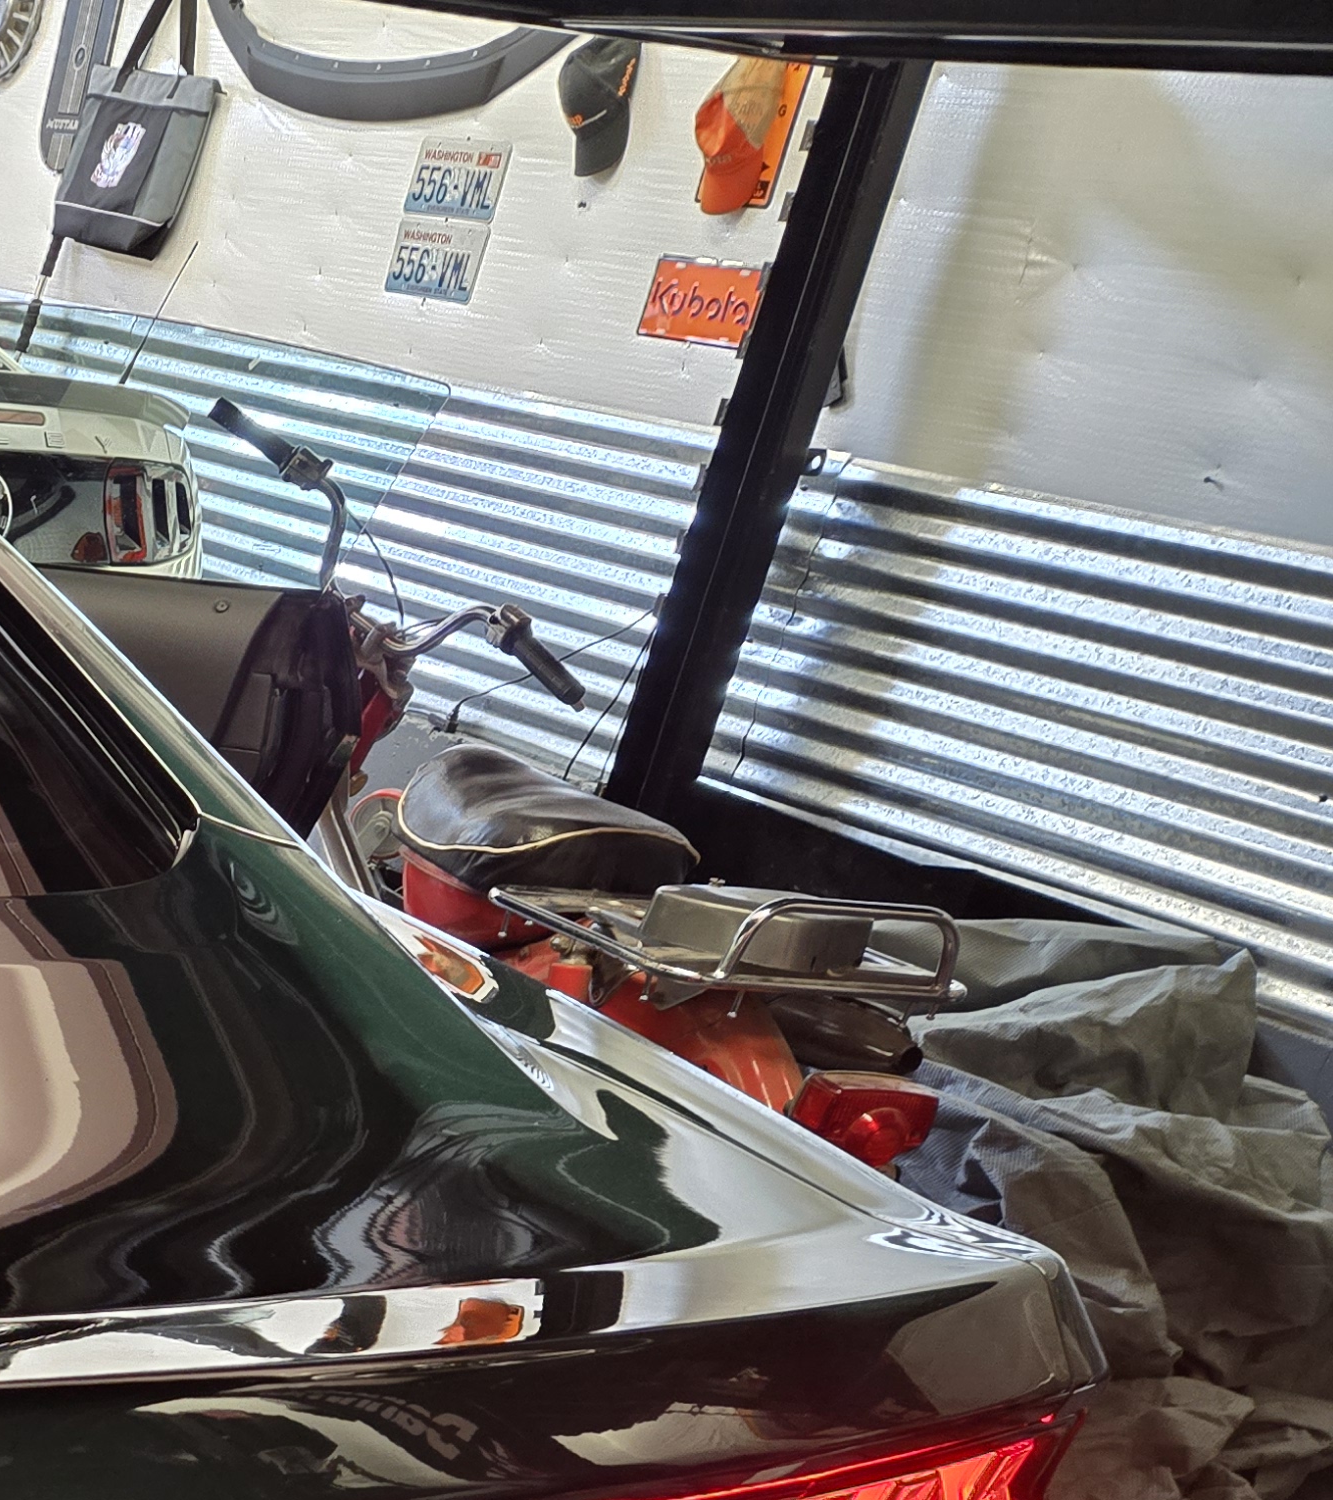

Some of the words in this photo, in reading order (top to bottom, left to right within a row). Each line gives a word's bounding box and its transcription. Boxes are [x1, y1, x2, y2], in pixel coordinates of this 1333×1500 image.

[424, 149, 474, 163] WASHINGTON
[403, 229, 453, 244] WASHINGTON
[650, 276, 750, 327] Kubota
